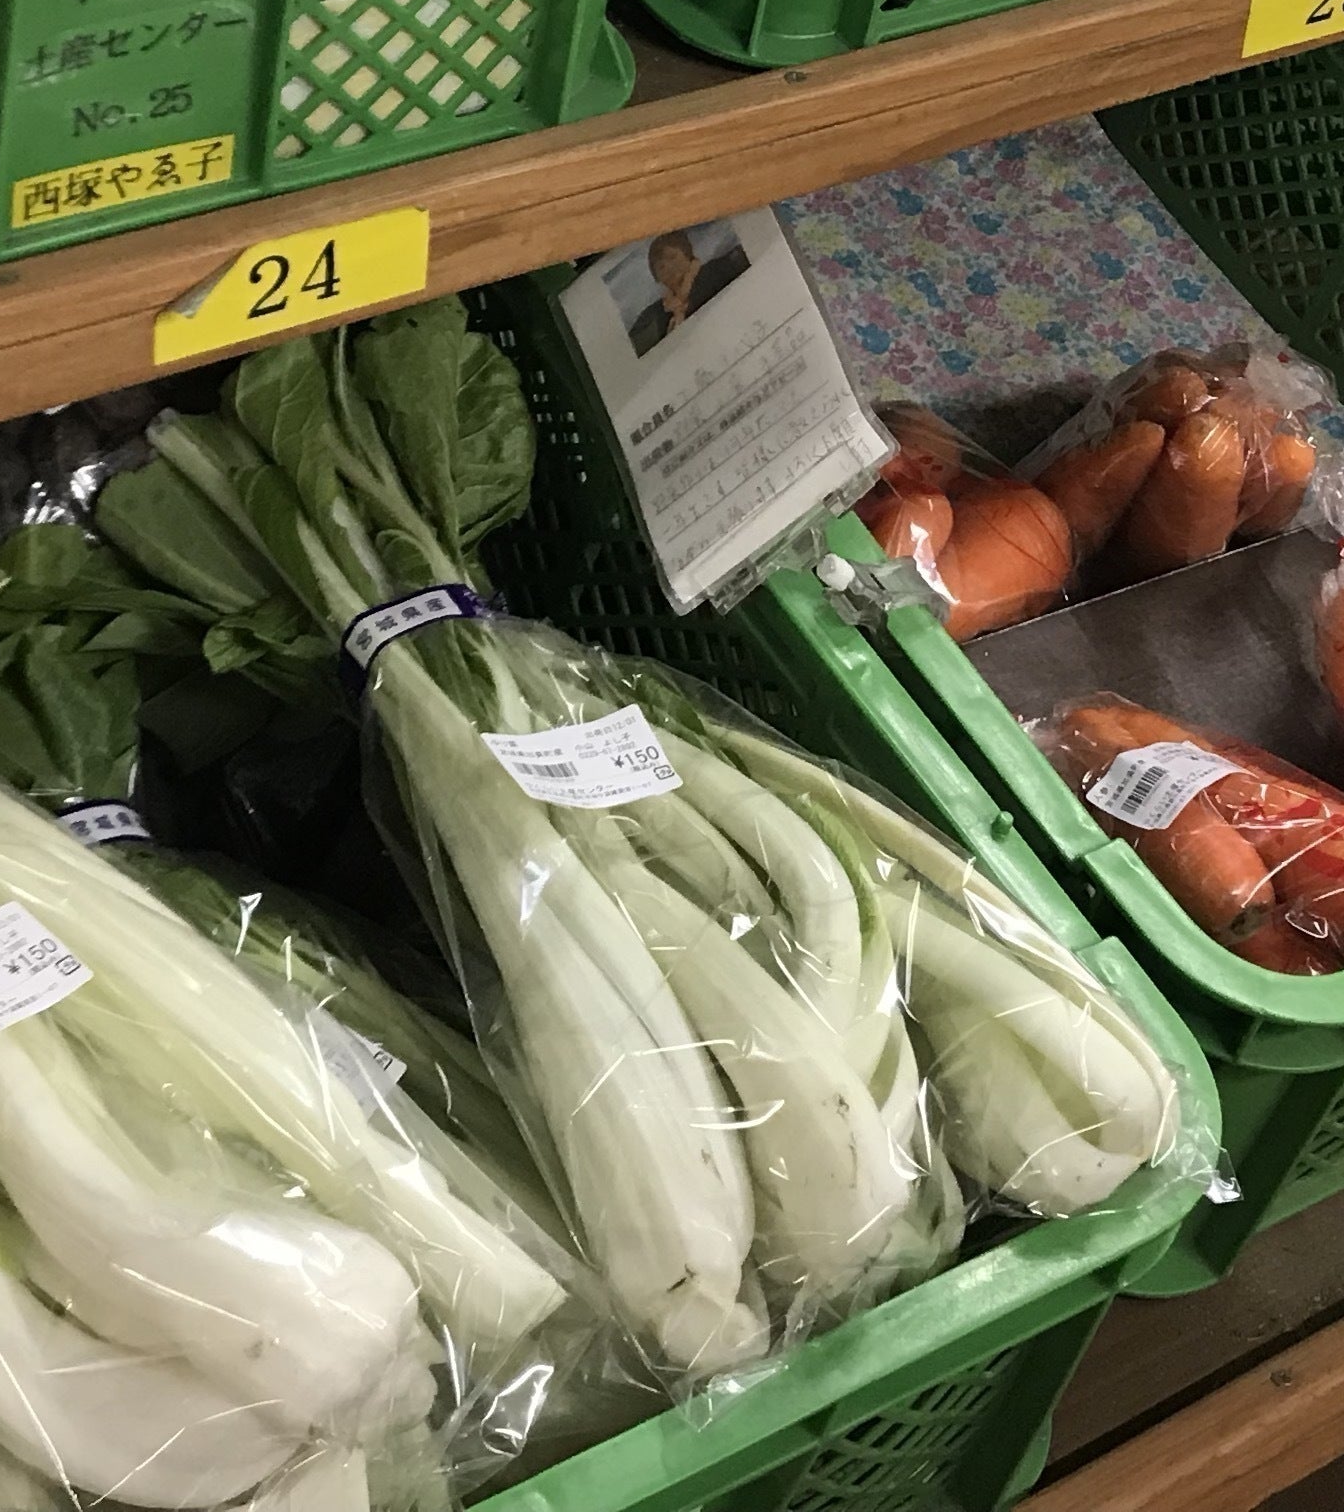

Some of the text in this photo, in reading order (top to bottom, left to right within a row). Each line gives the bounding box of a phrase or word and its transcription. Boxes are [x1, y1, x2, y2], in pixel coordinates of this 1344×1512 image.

[18, 12, 249, 85] 土産センター
[22, 141, 224, 221] 西塚やゑ子
[246, 240, 342, 321] 24
[610, 744, 661, 770] ¥150
[2, 937, 59, 976] ¥150
